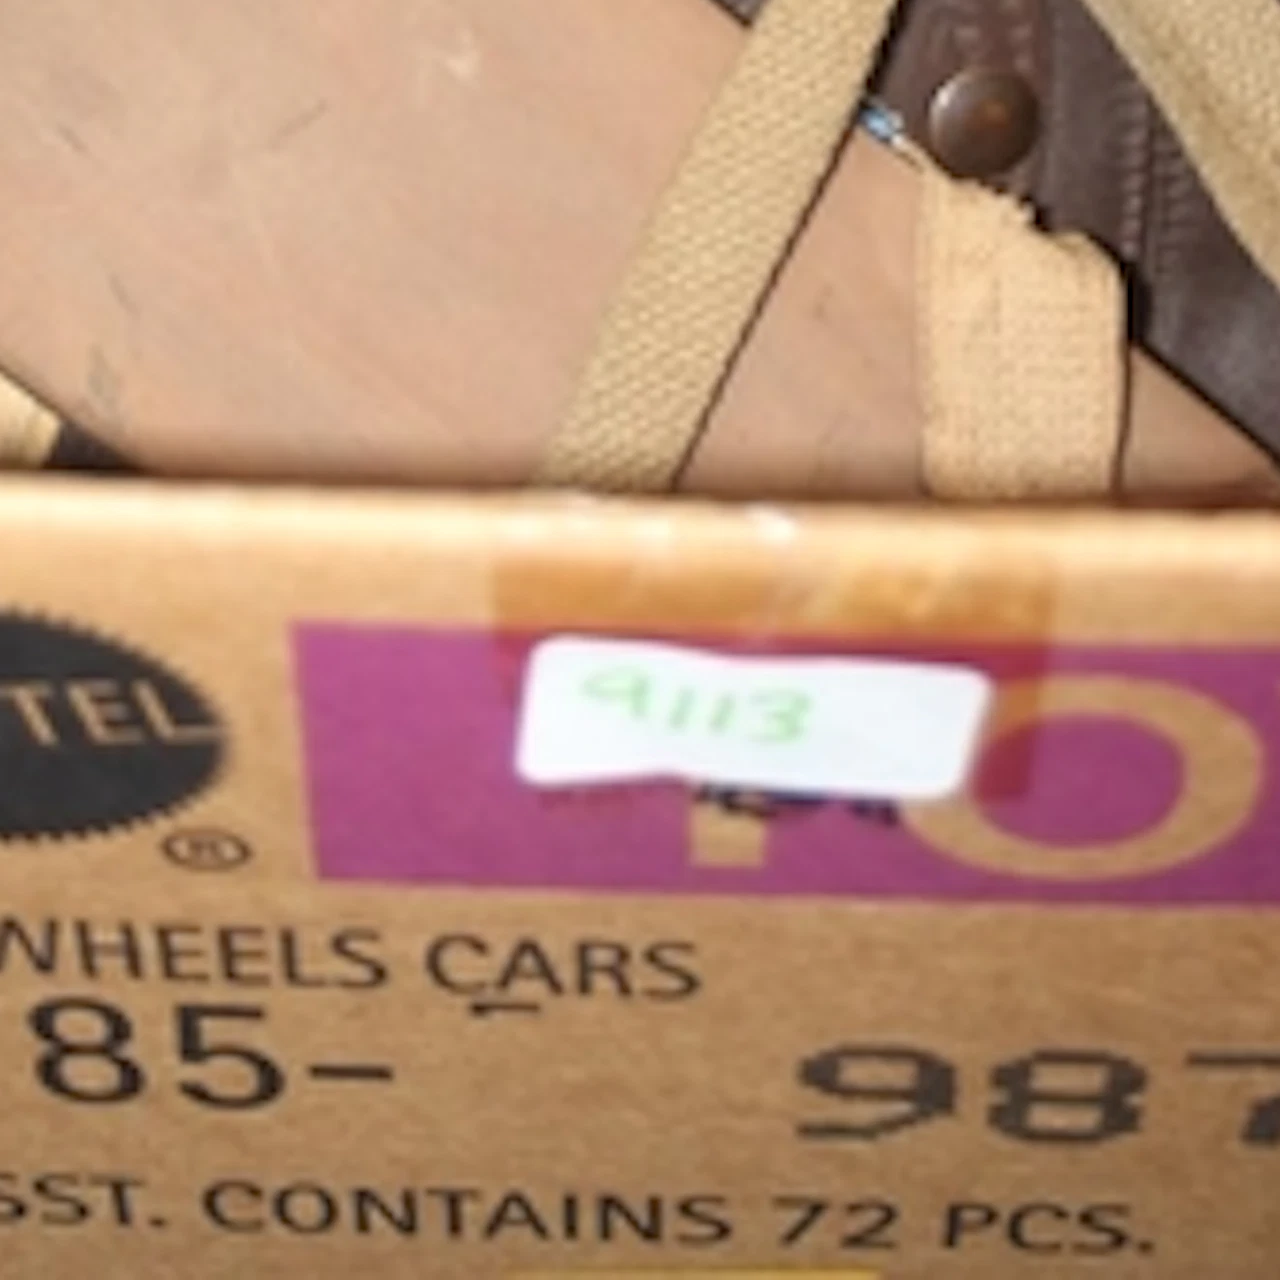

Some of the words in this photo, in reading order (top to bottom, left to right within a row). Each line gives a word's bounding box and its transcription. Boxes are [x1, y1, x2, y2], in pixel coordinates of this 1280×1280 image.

[426, 932, 704, 1000] CARS
[200, 1179, 734, 1244] CONTAINS
[772, 1197, 900, 1248] 72
[940, 1202, 1156, 1256] PCS.
